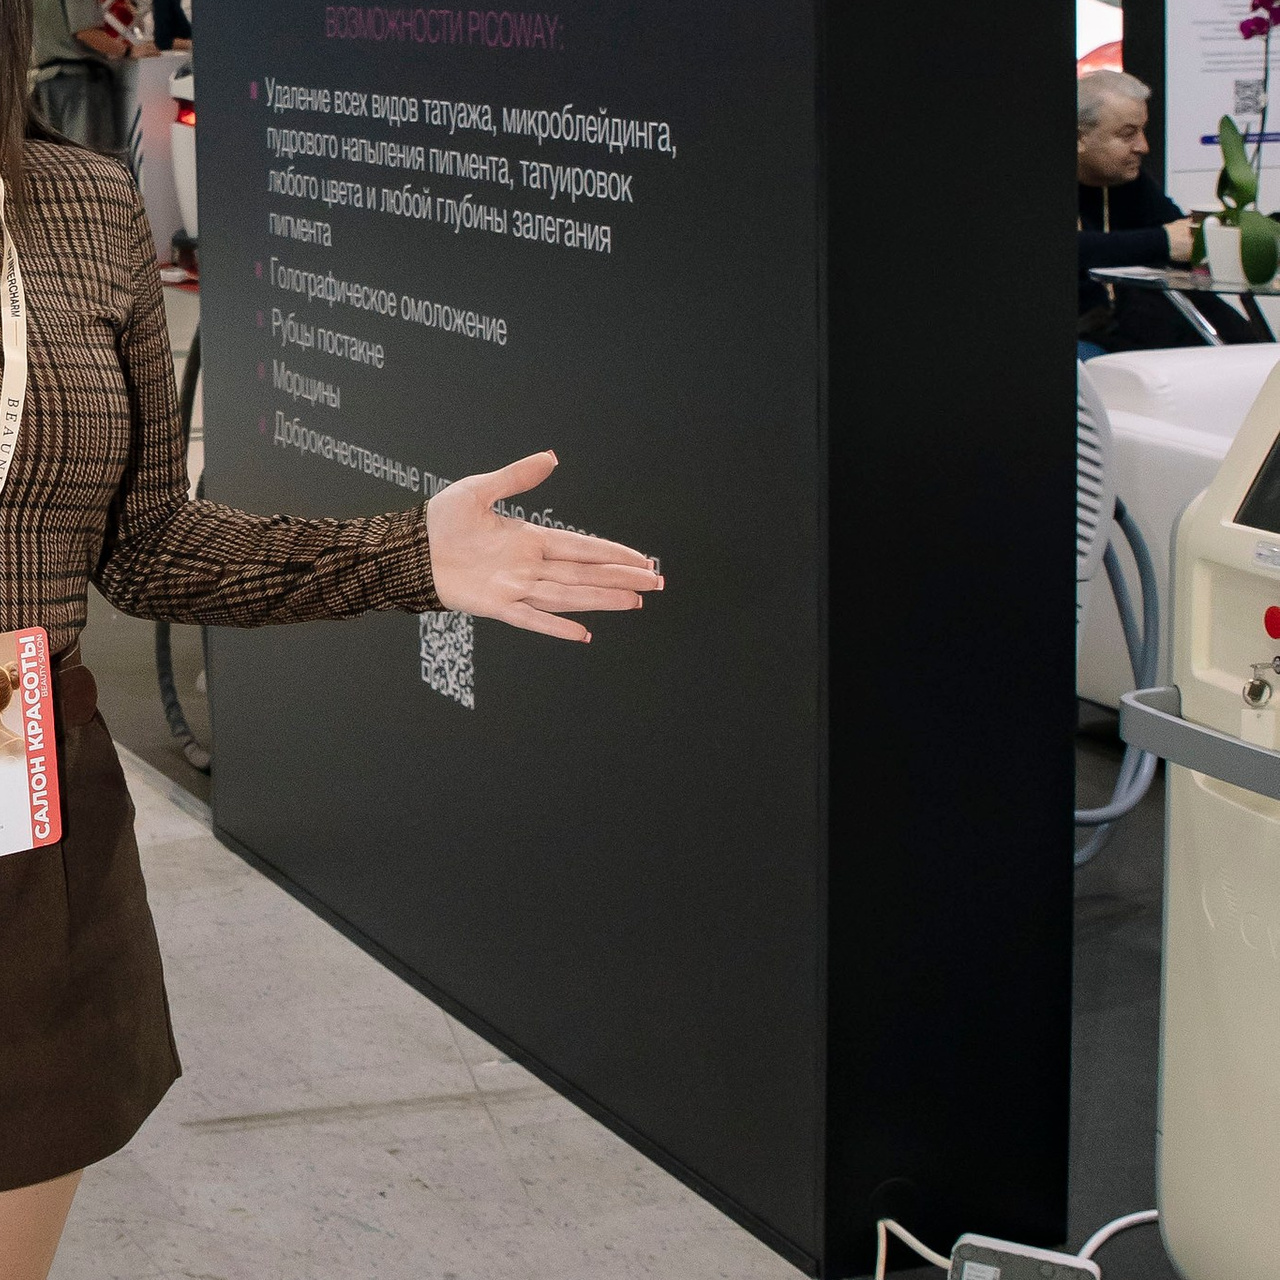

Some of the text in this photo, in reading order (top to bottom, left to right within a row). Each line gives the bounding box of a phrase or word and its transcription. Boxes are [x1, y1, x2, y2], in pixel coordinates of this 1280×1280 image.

[325, 6, 463, 44] ВОЗМОЖНОСТИ
[265, 77, 677, 159] Удаление всех видов татуажа, микроблейдинга,
[267, 127, 634, 203] пудрового напыления пигмента, татуировок
[268, 166, 611, 254] любого цвета и любой глубины залегания
[269, 212, 332, 247] пигмента
[270, 256, 508, 345] Голографическое омоложение
[271, 308, 385, 368] Рубцы постакне
[273, 359, 341, 409] Морщины
[274, 410, 420, 493] Доброкачественные
[35, 634, 49, 697] BEAUTY SALON
[18, 635, 51, 840] САЛОН КРАСОТЫ
